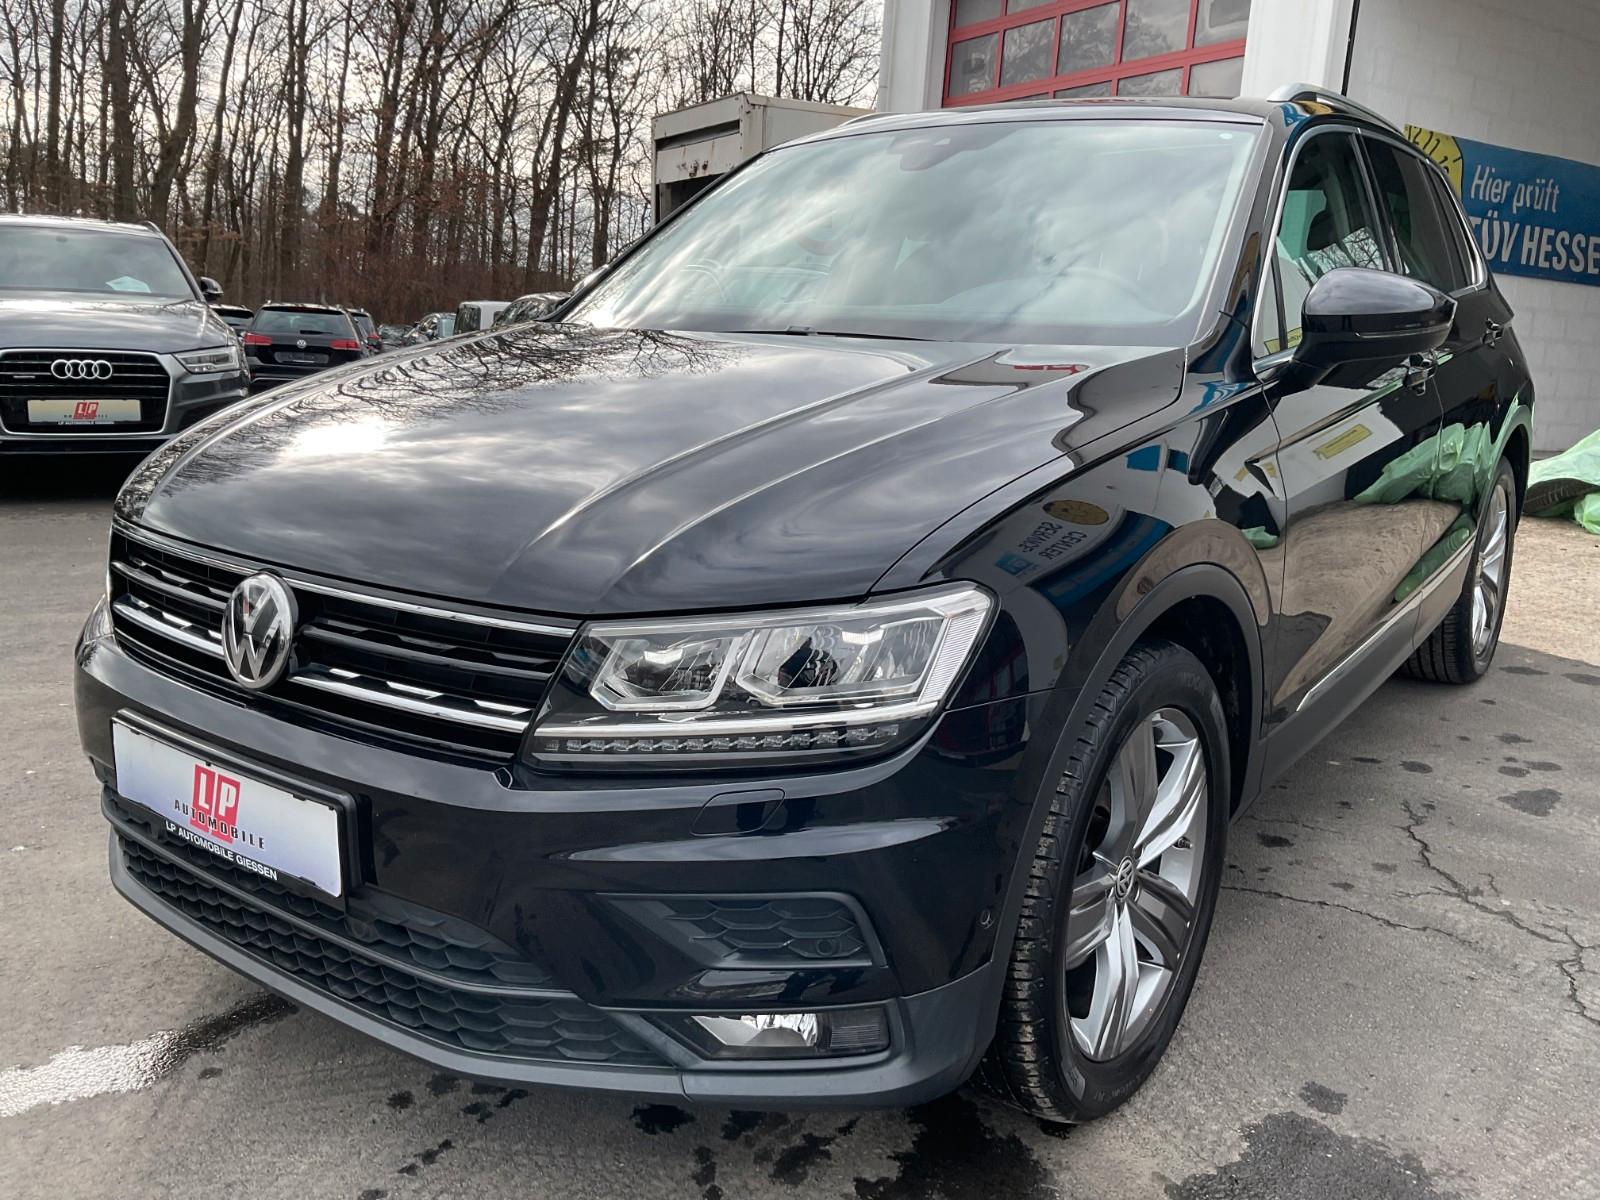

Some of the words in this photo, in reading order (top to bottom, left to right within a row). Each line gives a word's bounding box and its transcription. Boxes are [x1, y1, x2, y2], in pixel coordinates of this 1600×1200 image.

[1470, 164, 1510, 204] Hier
[1512, 178, 1560, 215] prüft
[1520, 226, 1600, 275] HESSE
[197, 771, 237, 817] LP
[173, 799, 266, 850] AUTOMOBILE
[165, 820, 177, 833] LP
[177, 827, 234, 862] AUTOMOBILE
[235, 853, 278, 881] GIESSEN
